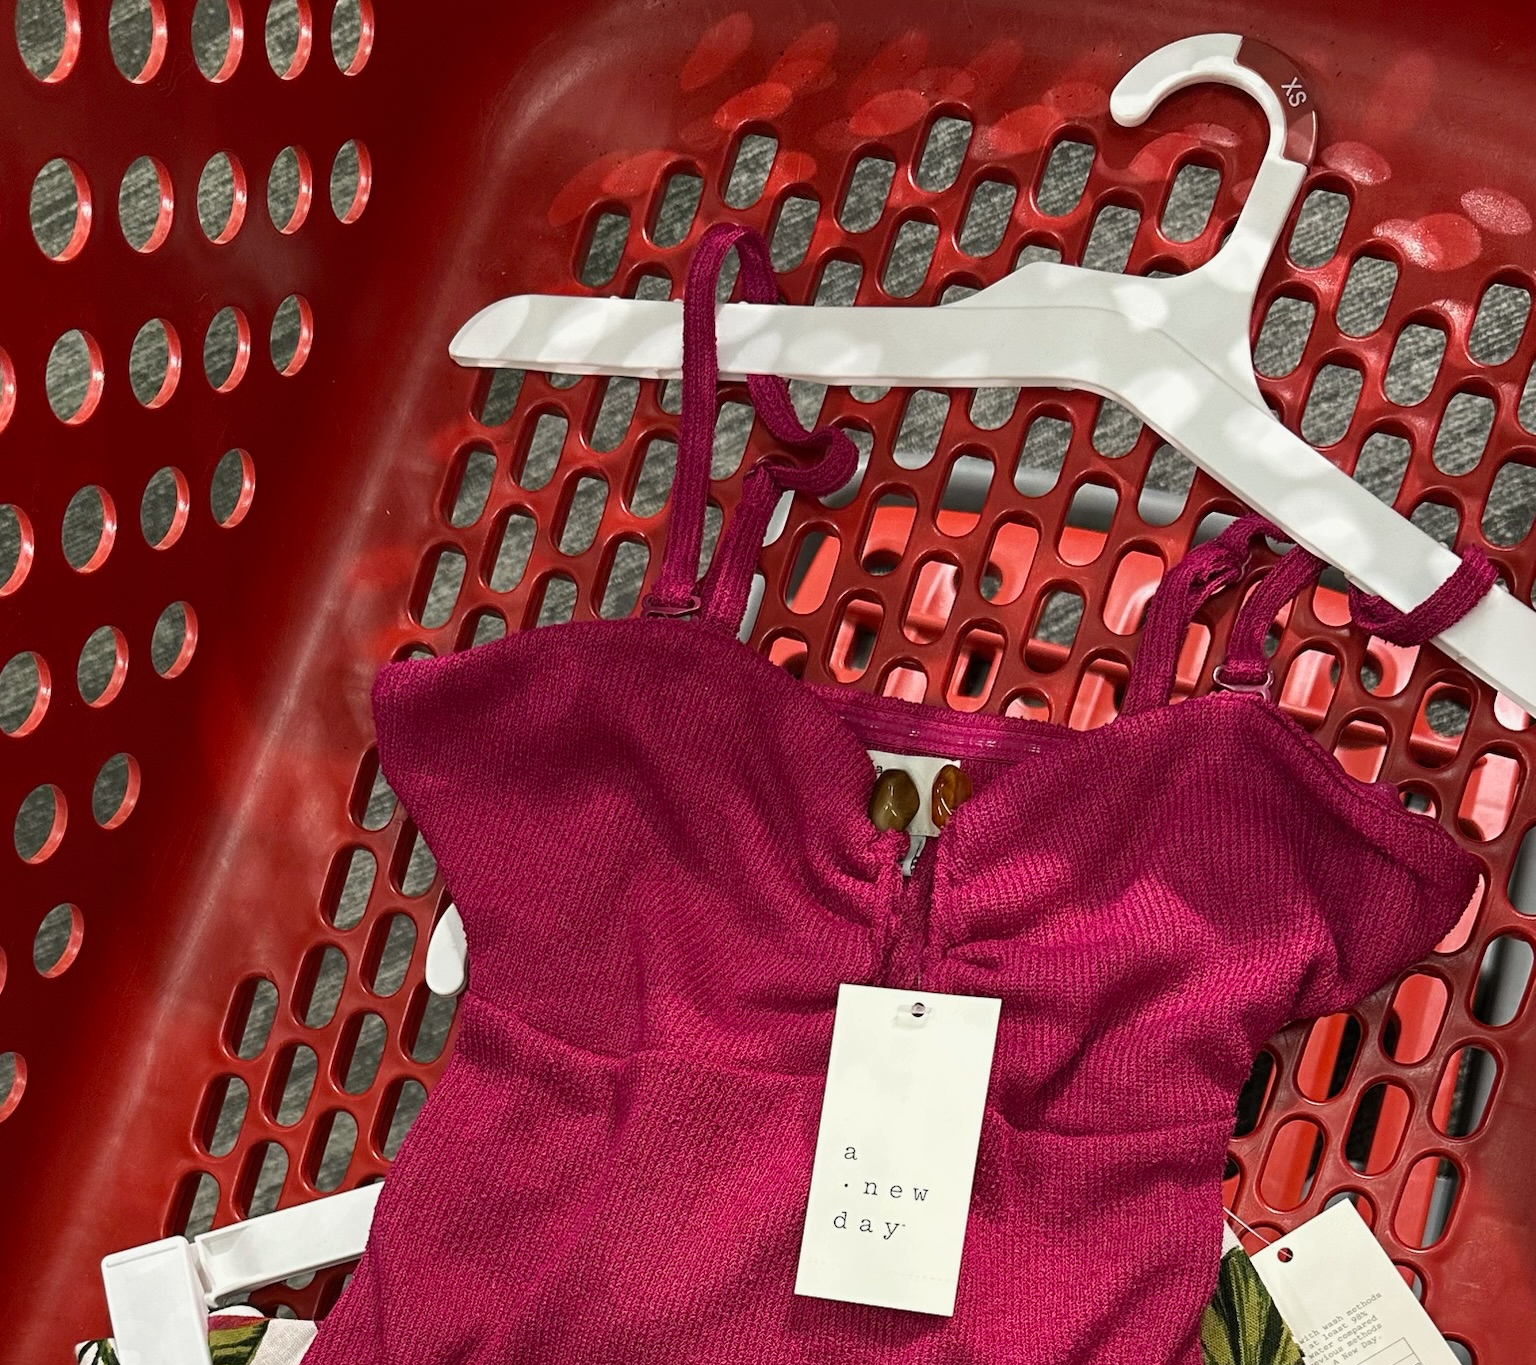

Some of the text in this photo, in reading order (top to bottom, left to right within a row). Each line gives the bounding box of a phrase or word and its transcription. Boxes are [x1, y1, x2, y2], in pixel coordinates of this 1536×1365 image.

[1281, 76, 1307, 107] XS
[844, 1146, 858, 1160] a
[1297, 1291, 1382, 1344] with wash methods
[1307, 1309, 1368, 1349] at least 98%
[1307, 1314, 1378, 1359] water compared
[1346, 1321, 1382, 1346] methods
[1341, 1346, 1358, 1360] New
